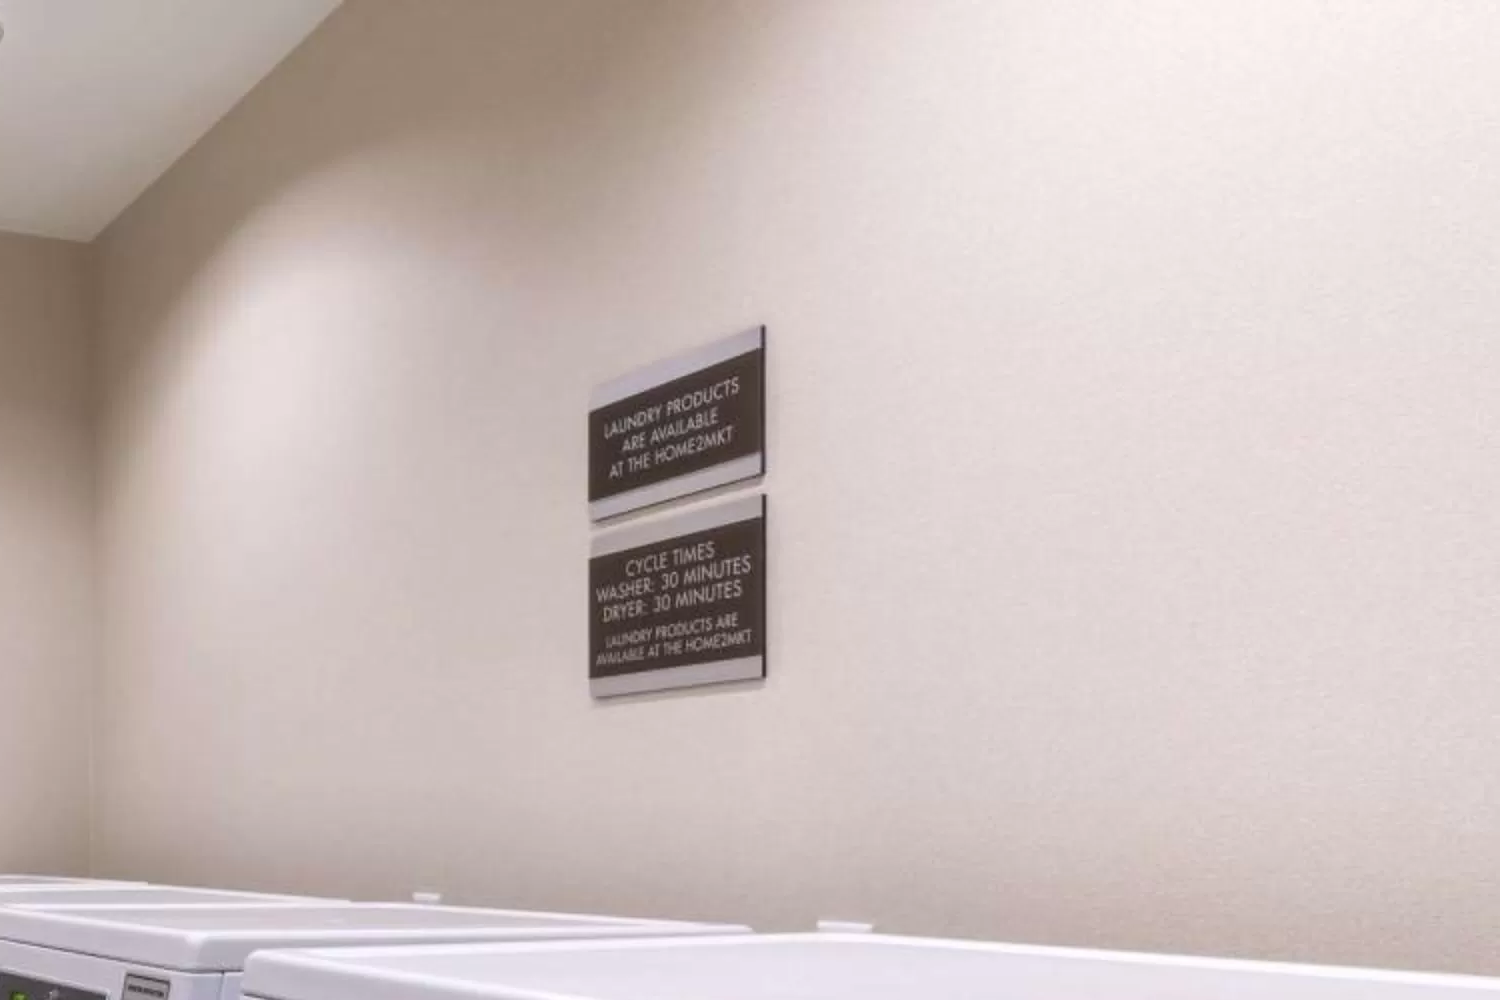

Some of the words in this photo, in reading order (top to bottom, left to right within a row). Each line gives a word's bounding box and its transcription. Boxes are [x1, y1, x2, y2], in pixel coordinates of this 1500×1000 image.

[604, 404, 662, 440] LAUNDRY
[666, 376, 740, 417] PRODUCTS
[622, 431, 646, 452] ARE
[650, 407, 719, 446] AVAILABLE
[608, 461, 624, 480] AT
[628, 453, 650, 473] THE
[655, 425, 733, 465] HOME2MKT
[625, 552, 669, 577] CYCLE
[673, 541, 716, 566] TIMES
[661, 571, 679, 591] 30
[683, 555, 751, 586] MINUTES
[653, 594, 671, 613] 30
[675, 579, 742, 609] MINUTES
[605, 627, 653, 649] LAUNDRY
[655, 618, 713, 641] PRODUCTS
[716, 612, 739, 630] ARE
[596, 646, 645, 666] AVAILABLE
[648, 643, 660, 658] AT
[664, 640, 683, 656] THE
